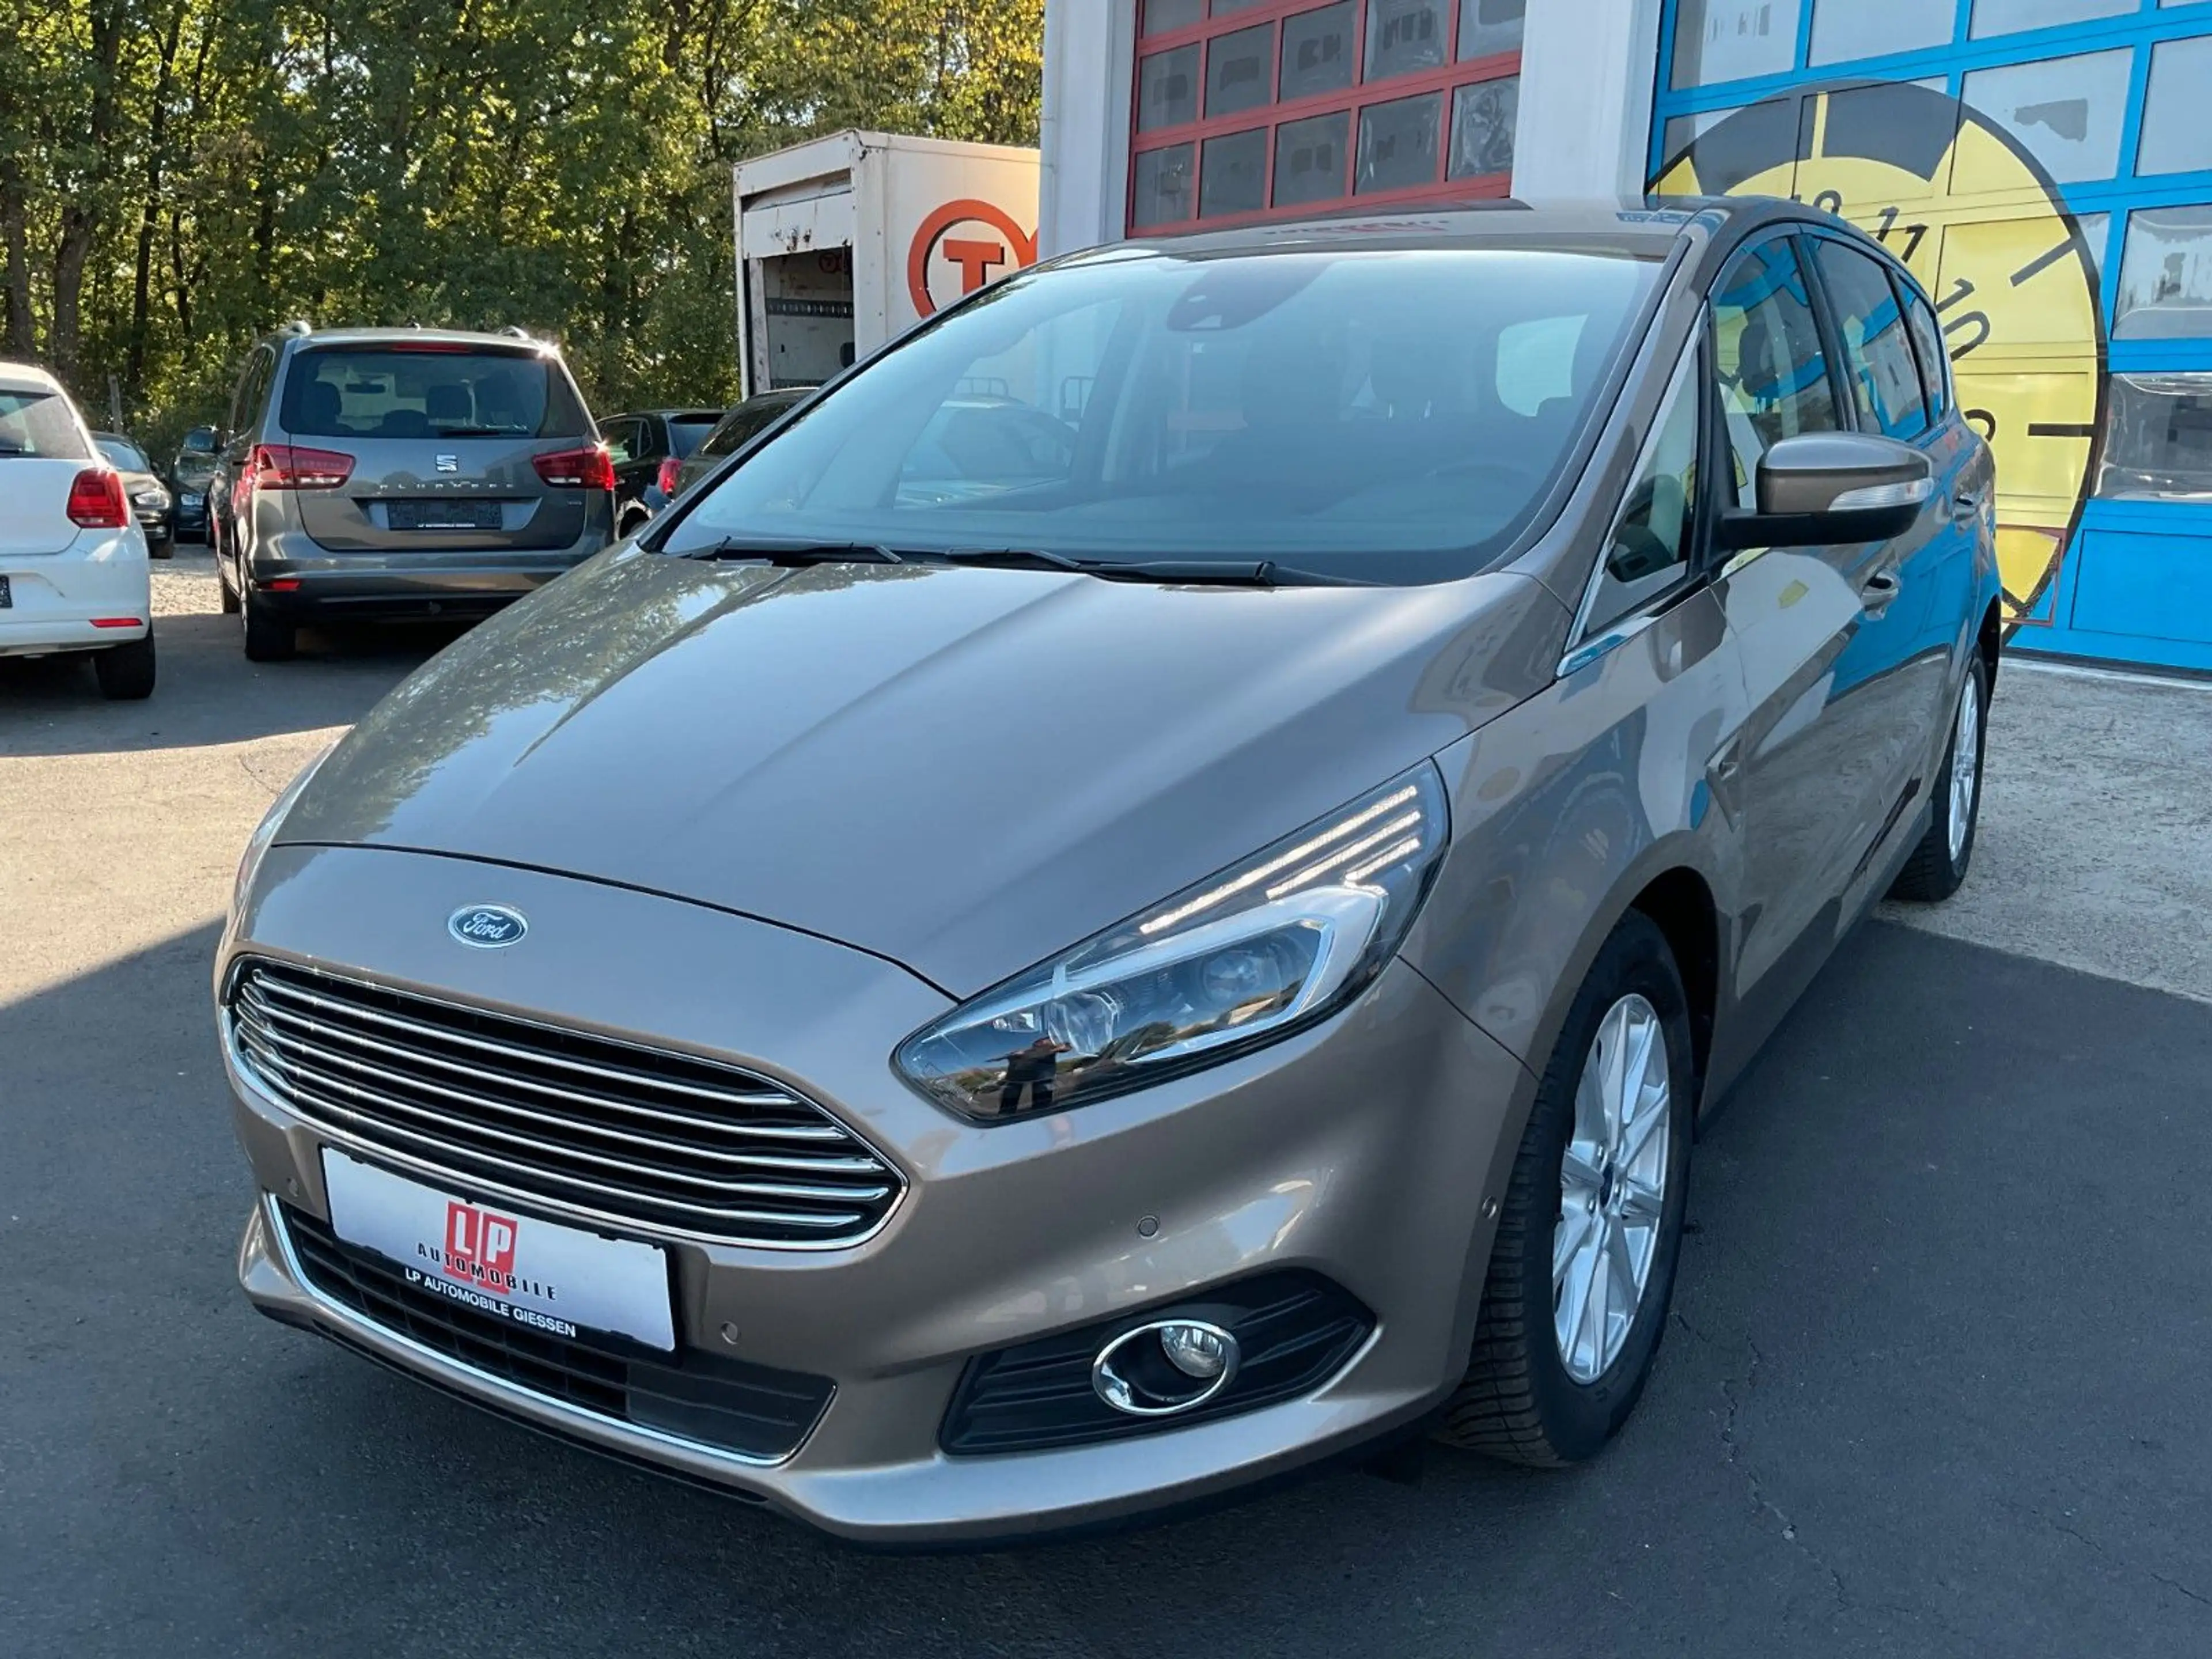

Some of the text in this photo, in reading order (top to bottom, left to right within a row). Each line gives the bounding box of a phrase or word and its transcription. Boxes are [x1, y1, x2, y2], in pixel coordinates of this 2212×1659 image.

[1876, 206, 1928, 263] 11
[463, 912, 511, 938] Ford
[454, 1210, 512, 1263] LP
[417, 1242, 557, 1301] AUTOMOBILE
[405, 1267, 576, 1338] LP AUTOMOBILE GIESSEN
